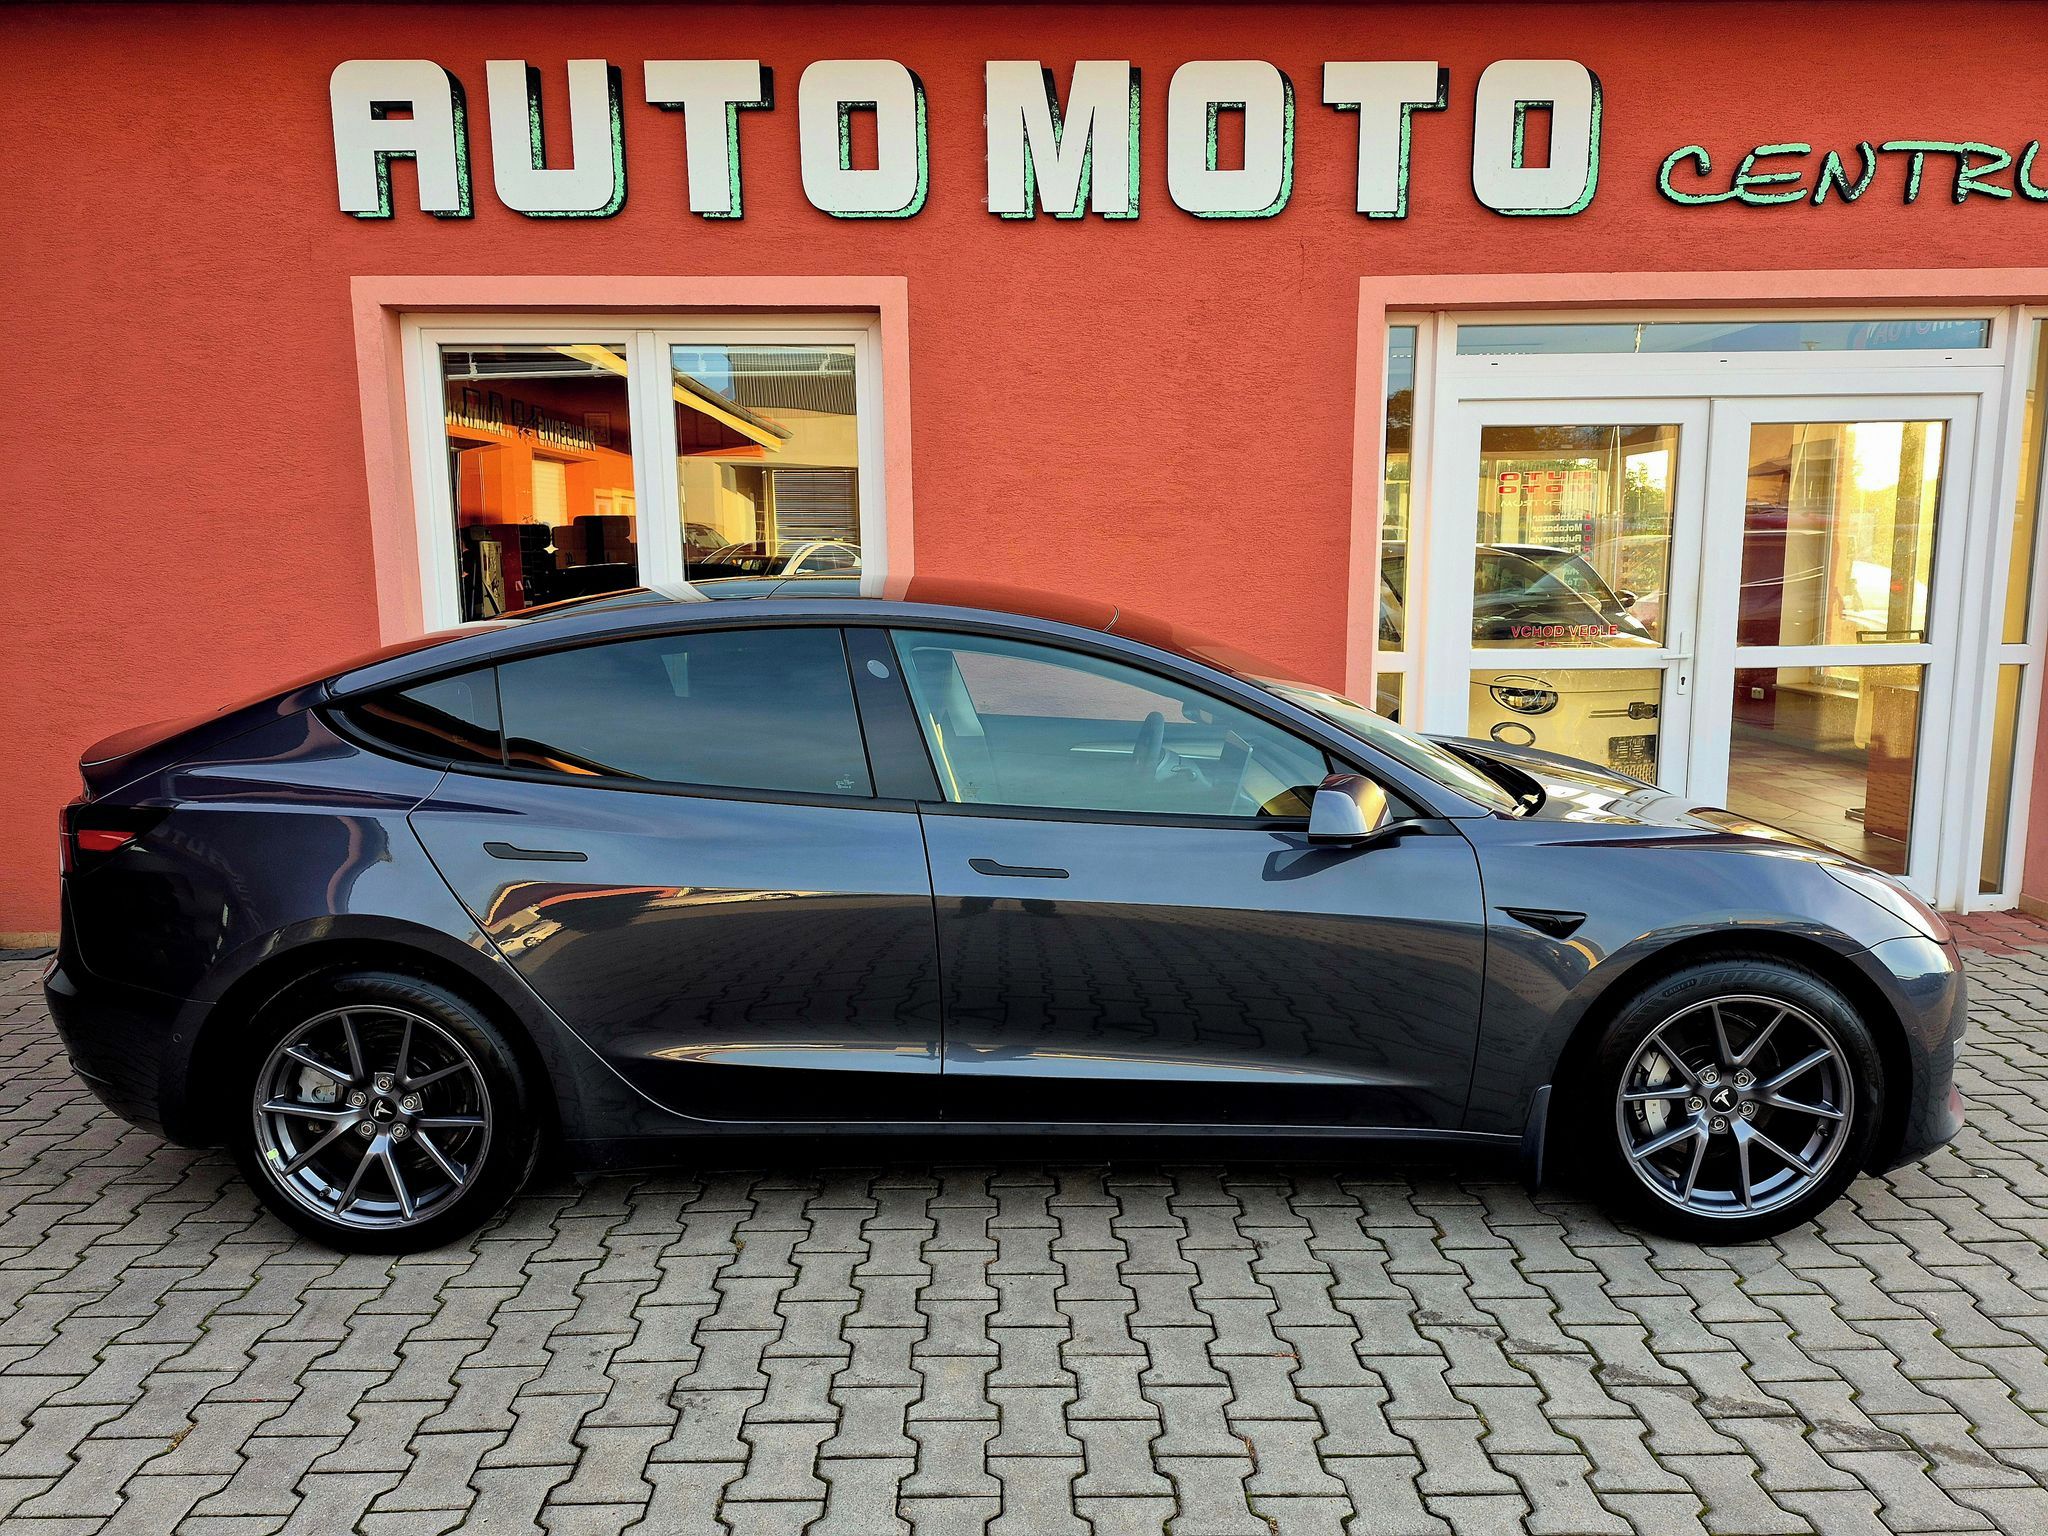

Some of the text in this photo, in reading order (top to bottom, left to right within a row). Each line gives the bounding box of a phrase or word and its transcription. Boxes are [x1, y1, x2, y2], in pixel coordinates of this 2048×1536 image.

[329, 59, 928, 219] AUTO
[985, 59, 1603, 219] MOTO
[1510, 624, 1618, 637] VCHOD VEDLE
